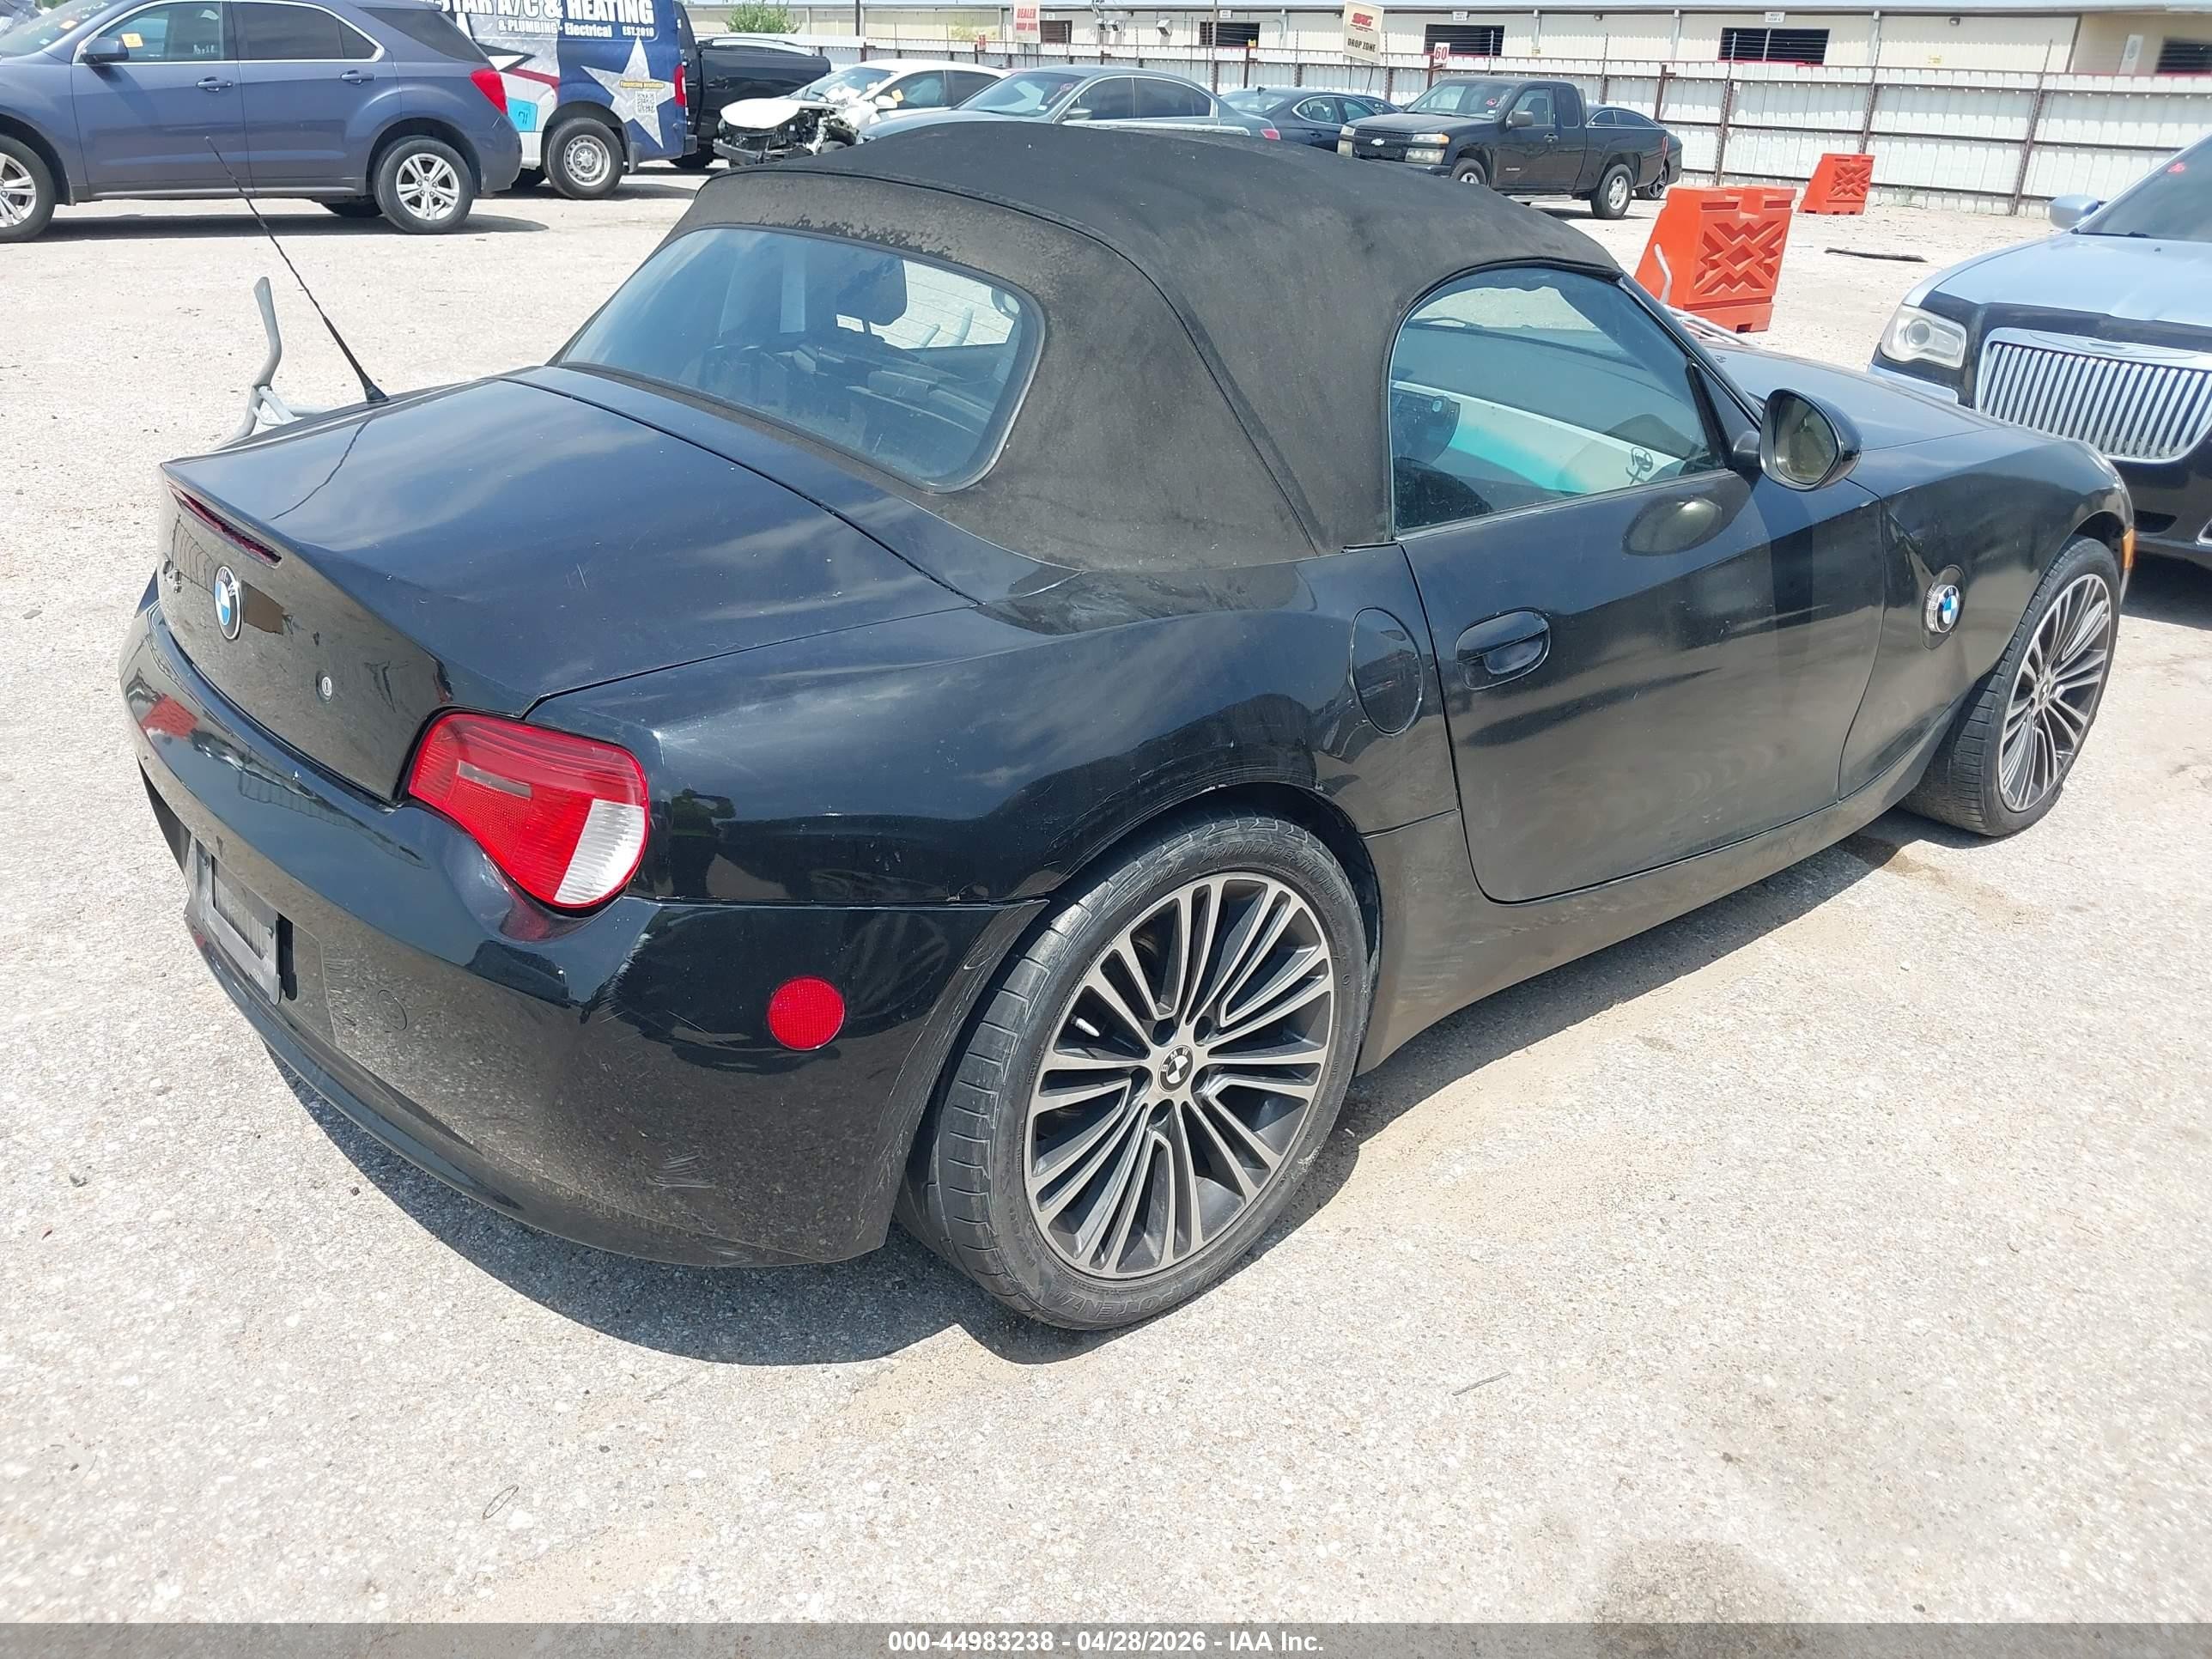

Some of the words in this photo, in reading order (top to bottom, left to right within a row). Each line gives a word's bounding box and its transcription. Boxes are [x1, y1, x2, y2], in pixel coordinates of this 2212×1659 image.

[567, 0, 655, 24] HEATING
[507, 20, 557, 34] PLUMBING
[564, 22, 612, 37] Electrical
[1347, 38, 1363, 48] DROP
[1362, 41, 1376, 52] ZONE
[1435, 46, 1448, 60] 60
[1160, 1047, 1189, 1072] BMW
